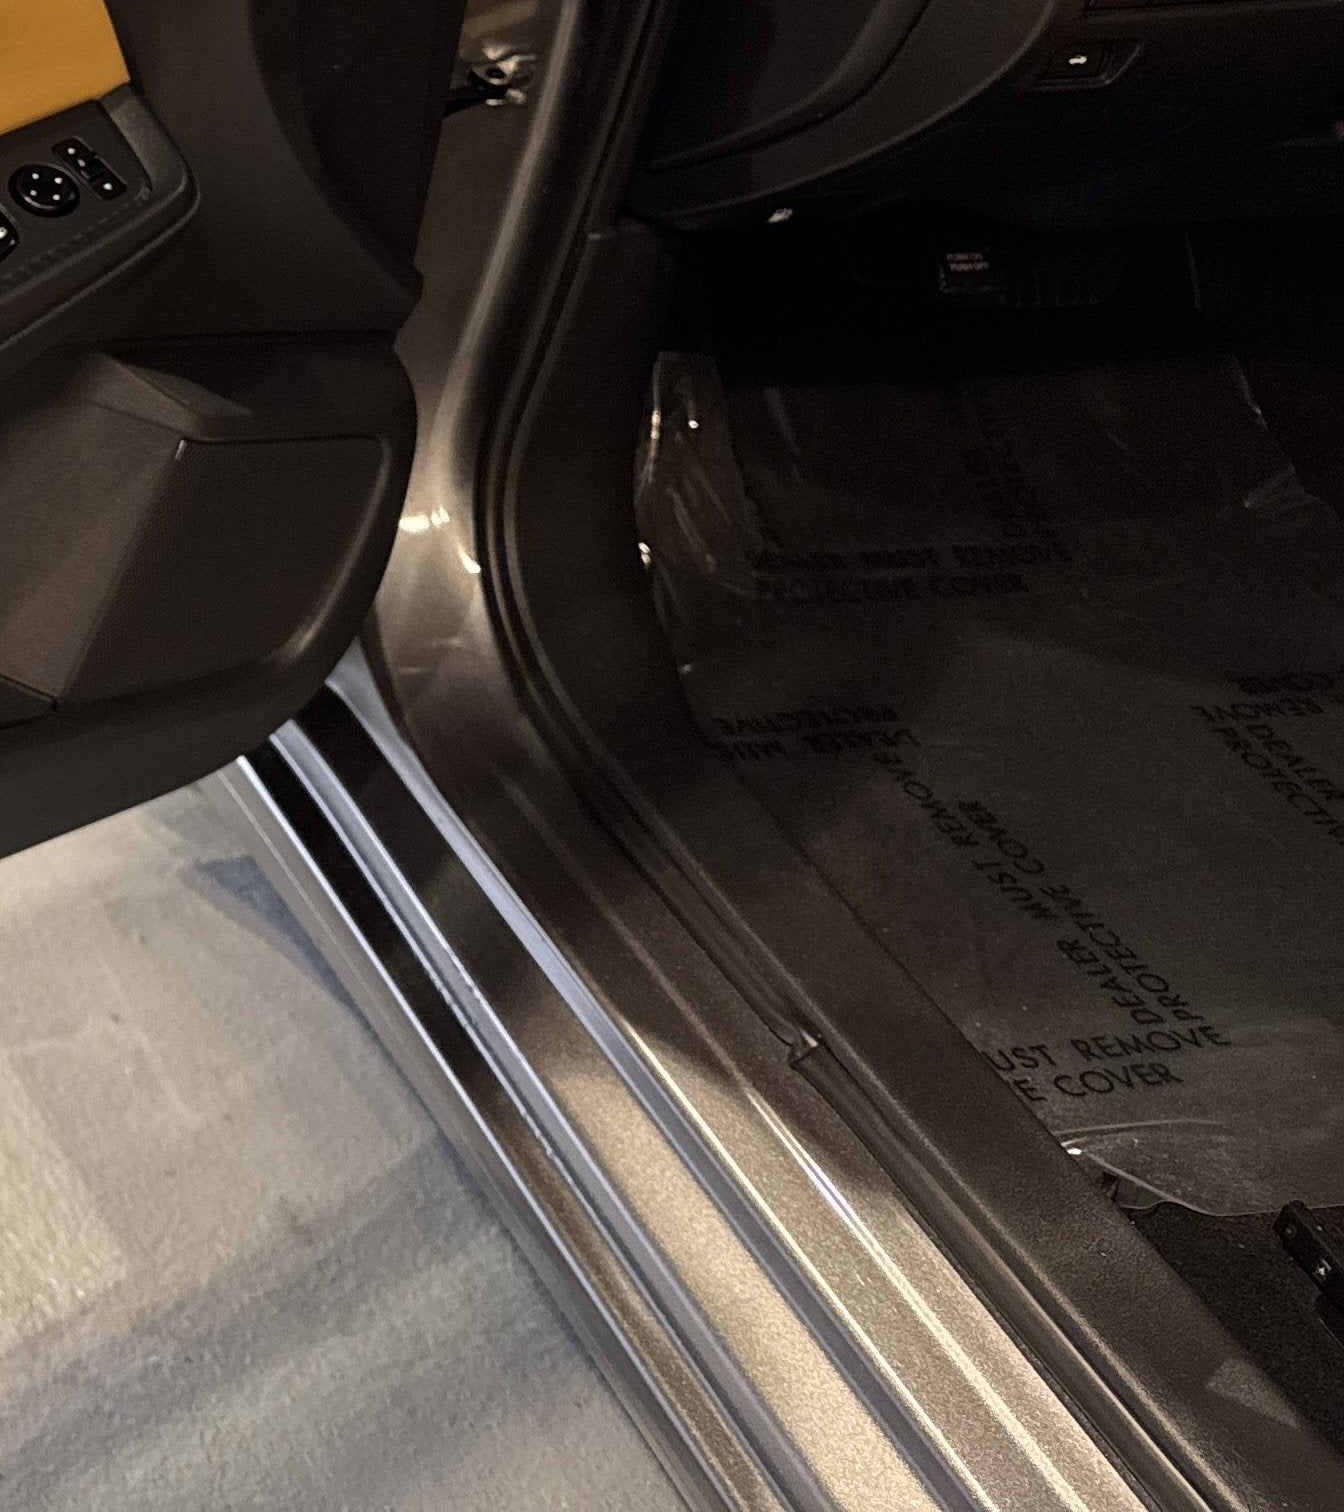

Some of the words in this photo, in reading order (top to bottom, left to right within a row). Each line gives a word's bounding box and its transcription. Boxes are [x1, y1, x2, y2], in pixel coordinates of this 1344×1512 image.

[958, 799, 1046, 876] COVER
[972, 857, 1059, 922] MUST
[1039, 883, 1204, 1023] PROTECTIVE
[1055, 938, 1166, 1026] DEALER
[1070, 1024, 1232, 1063] REMOVE
[1053, 1062, 1184, 1100] COVER
